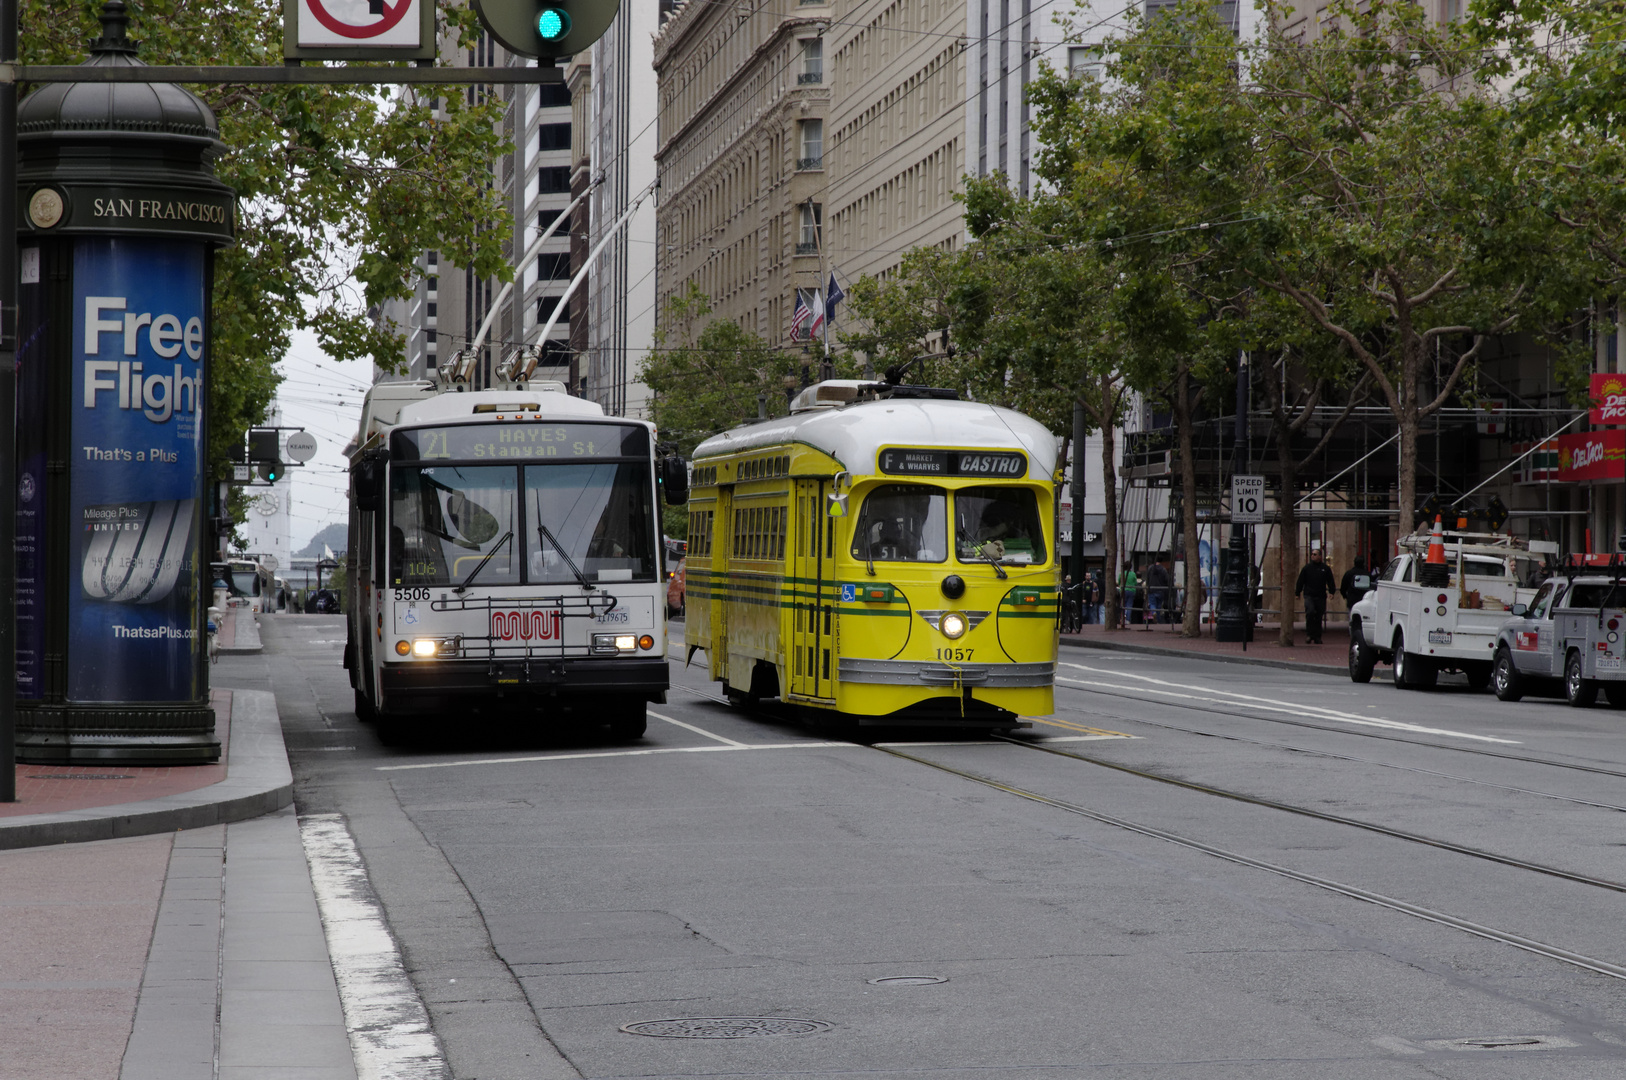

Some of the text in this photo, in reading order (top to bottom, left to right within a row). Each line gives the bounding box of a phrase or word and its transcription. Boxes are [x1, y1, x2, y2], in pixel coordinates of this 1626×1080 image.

[94, 198, 225, 224] SAN FRANCISCO
[85, 296, 203, 361] Free
[84, 360, 202, 423] Flight
[1605, 395, 1626, 407] DE
[1600, 406, 1626, 420] TAC
[499, 428, 567, 442] HAYES
[423, 431, 451, 458] 21
[473, 443, 557, 457] Stanyan
[83, 446, 132, 461] That's
[136, 451, 145, 461] a
[905, 454, 933, 462] MARKET
[884, 453, 893, 469] F
[898, 462, 940, 471] & WHARVES
[960, 455, 1021, 473] CASTRO
[1235, 478, 1262, 486] SPEED
[1238, 497, 1258, 513] 10
[84, 507, 138, 519] Mileage Plus
[93, 522, 139, 531] UNITED
[881, 546, 897, 559] 51
[409, 562, 437, 576] 106
[394, 587, 430, 601] 5506
[112, 625, 198, 639] ThatsaPlus.com
[936, 648, 975, 661] 1057
